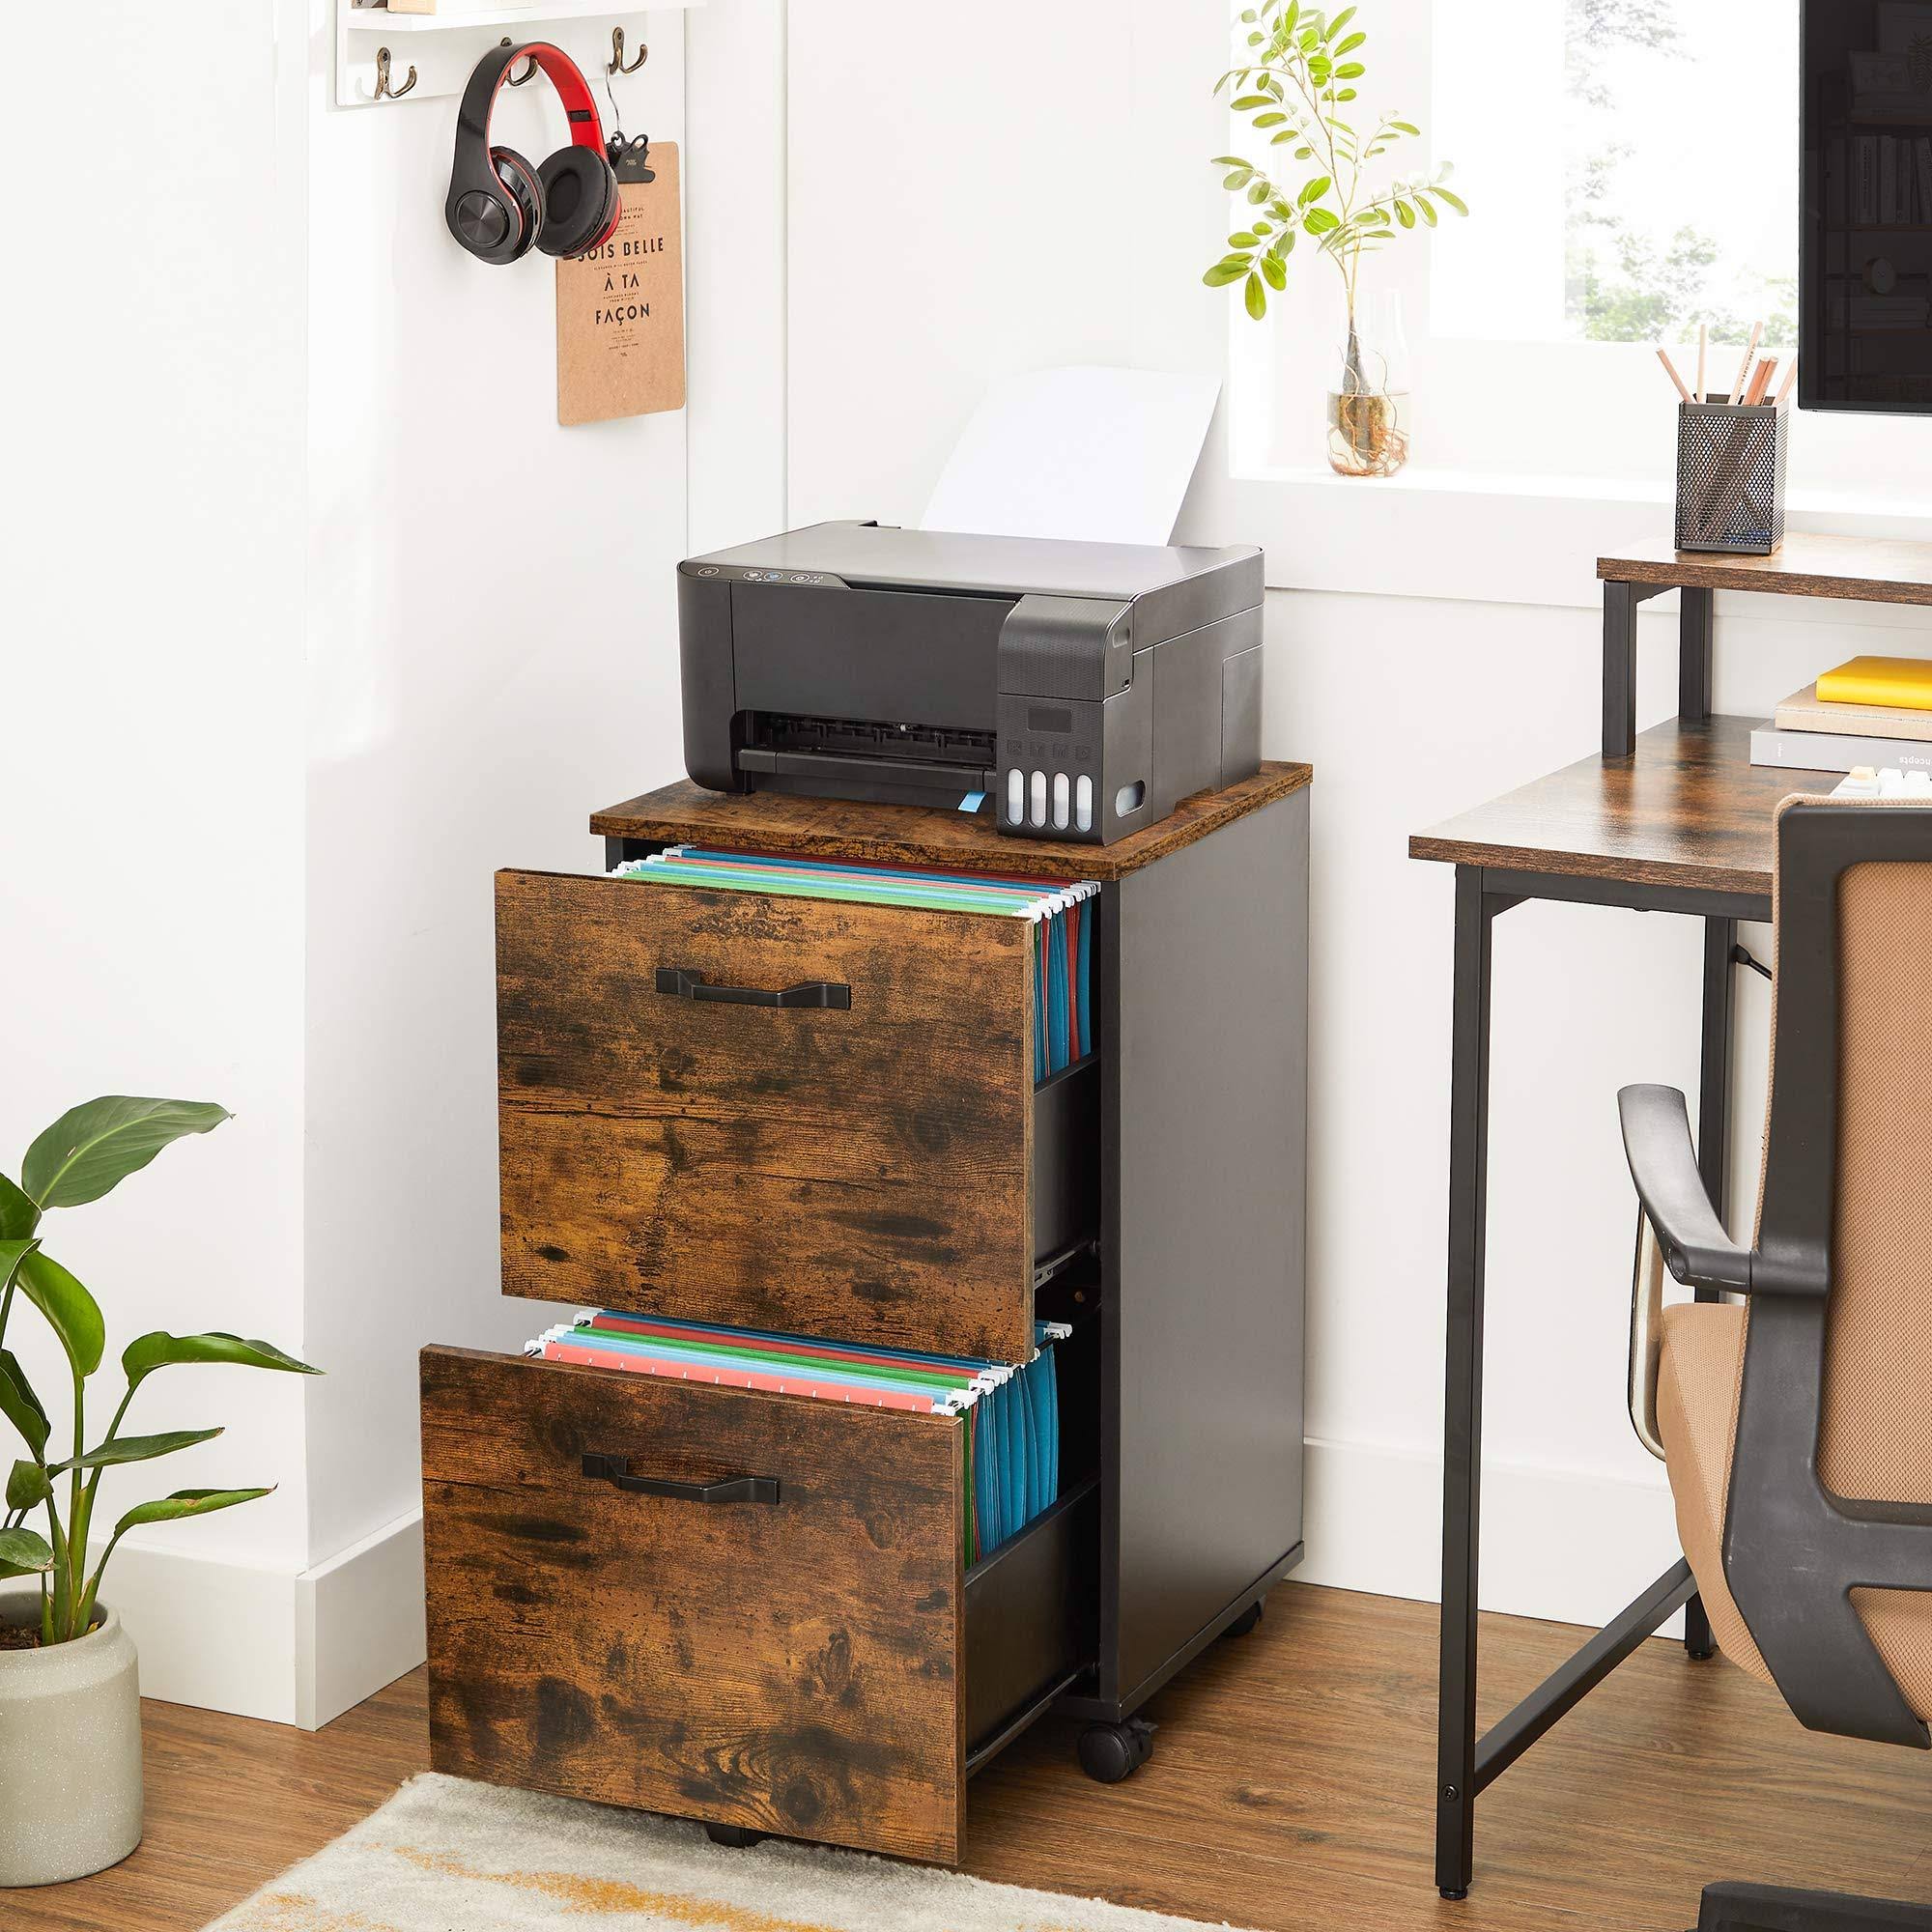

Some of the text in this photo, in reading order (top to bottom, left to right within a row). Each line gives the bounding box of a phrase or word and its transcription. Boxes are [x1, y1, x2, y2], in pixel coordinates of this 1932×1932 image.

[623, 238, 664, 256] BELLE
[604, 272, 639, 291] À TA
[596, 303, 650, 326] FAÇON
[1899, 755, 1932, 765] ncepts
